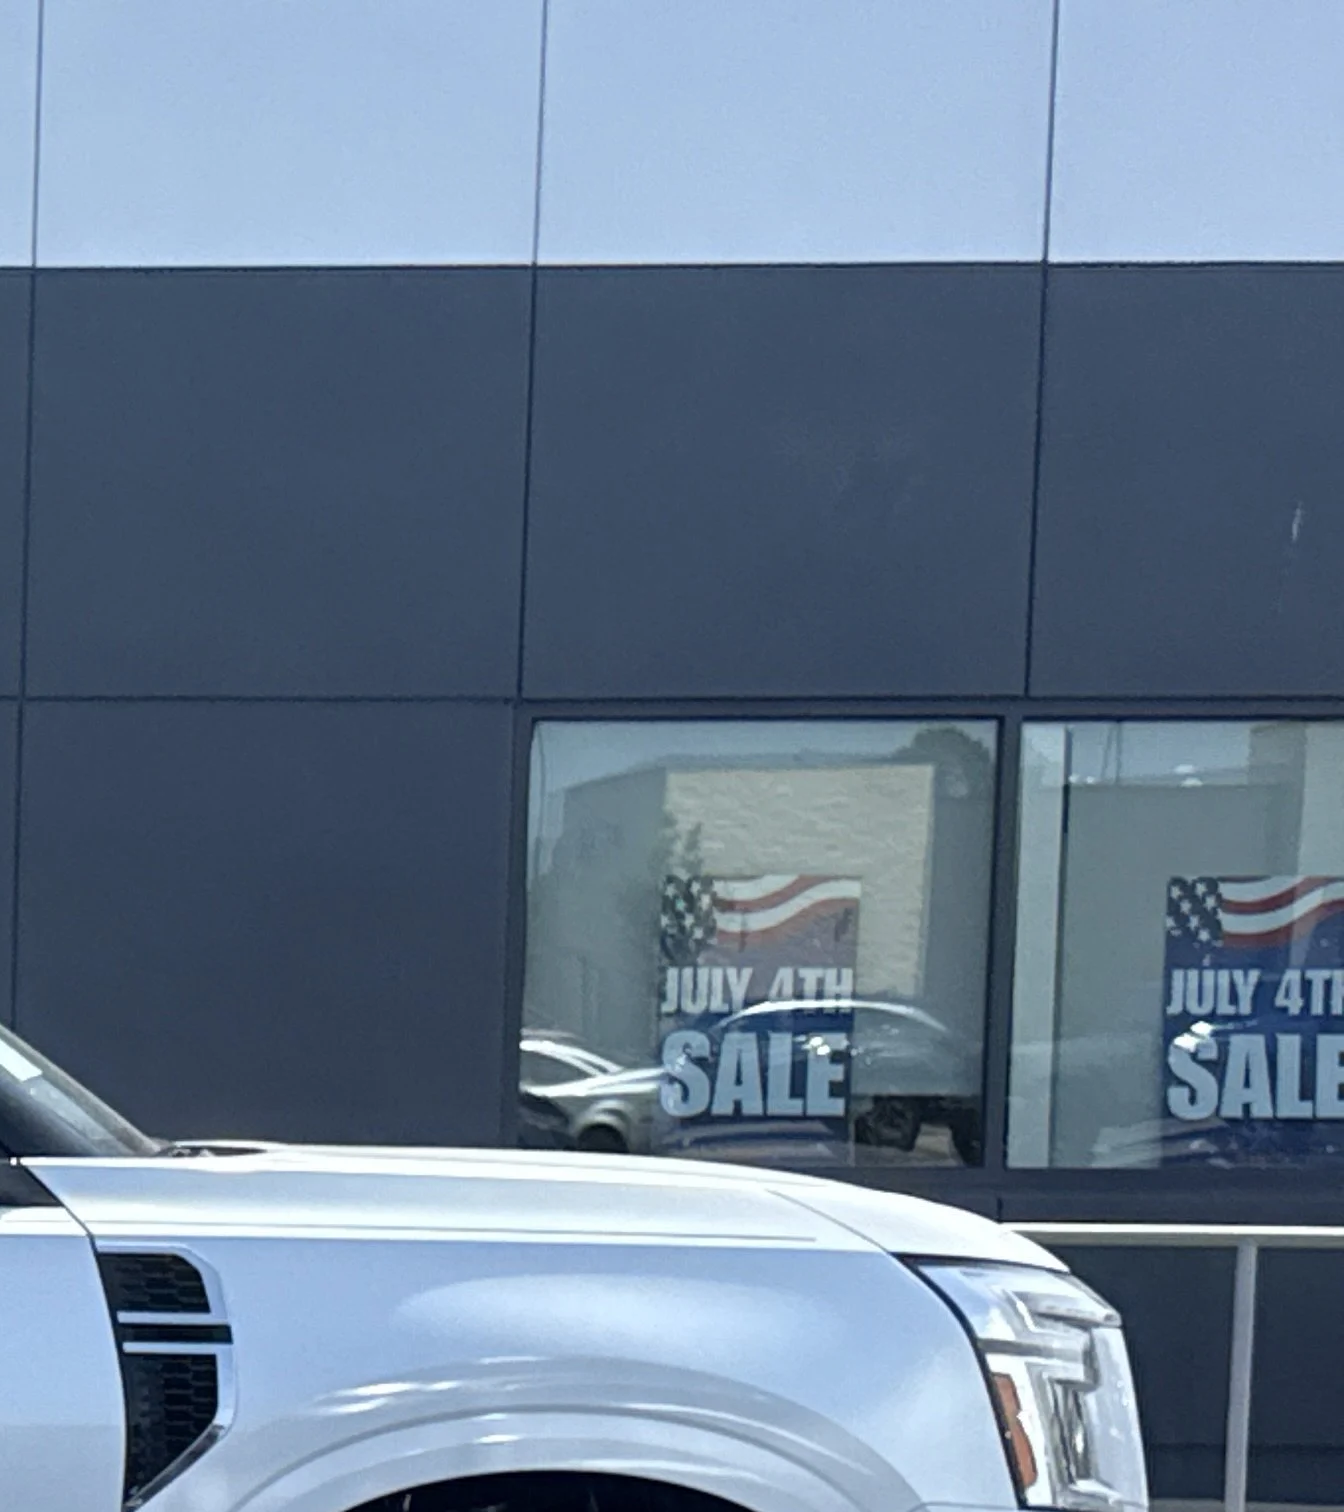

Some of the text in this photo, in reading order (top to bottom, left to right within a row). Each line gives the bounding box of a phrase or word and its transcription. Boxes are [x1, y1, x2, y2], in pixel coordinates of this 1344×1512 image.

[662, 966, 854, 1014] JULY 4TH
[1166, 968, 1261, 1016] JULY
[661, 1030, 847, 1117] SALE
[1167, 1030, 1344, 1120] SALE
